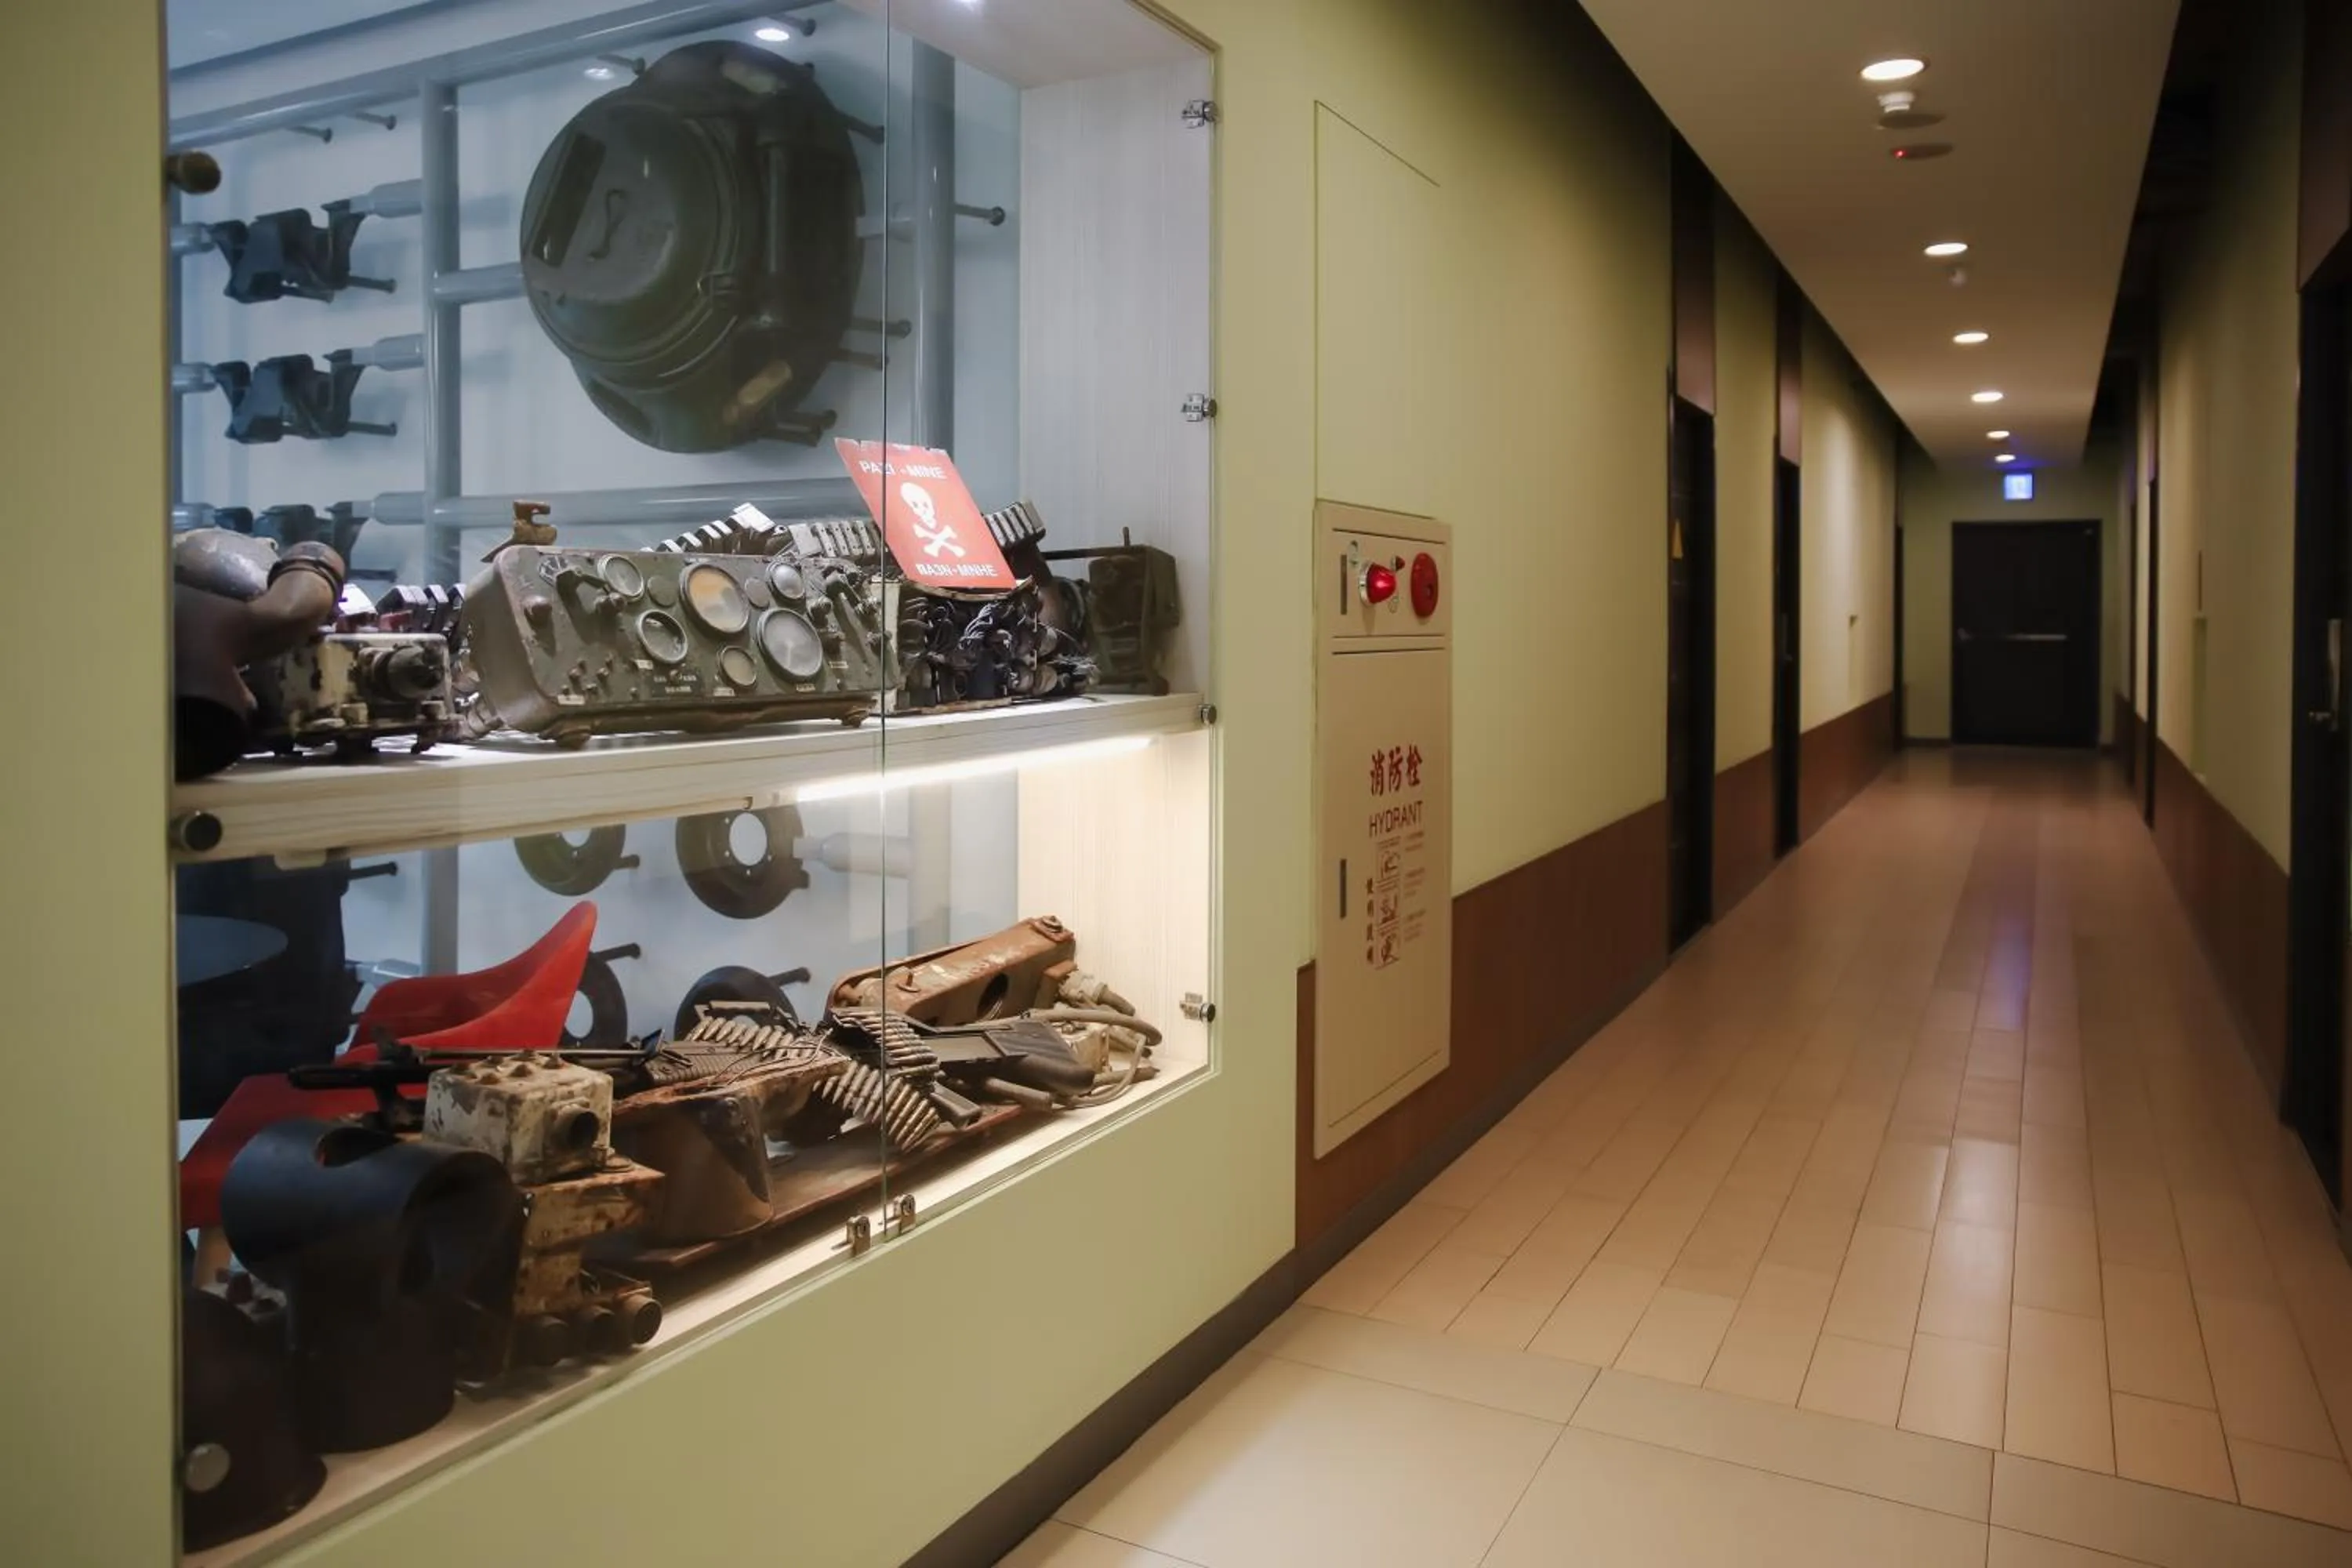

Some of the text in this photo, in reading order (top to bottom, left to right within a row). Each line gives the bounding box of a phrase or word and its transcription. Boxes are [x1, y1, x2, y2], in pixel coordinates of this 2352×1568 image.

[1370, 744, 1422, 797] 消防栓
[1369, 800, 1424, 838] HYDRANT
